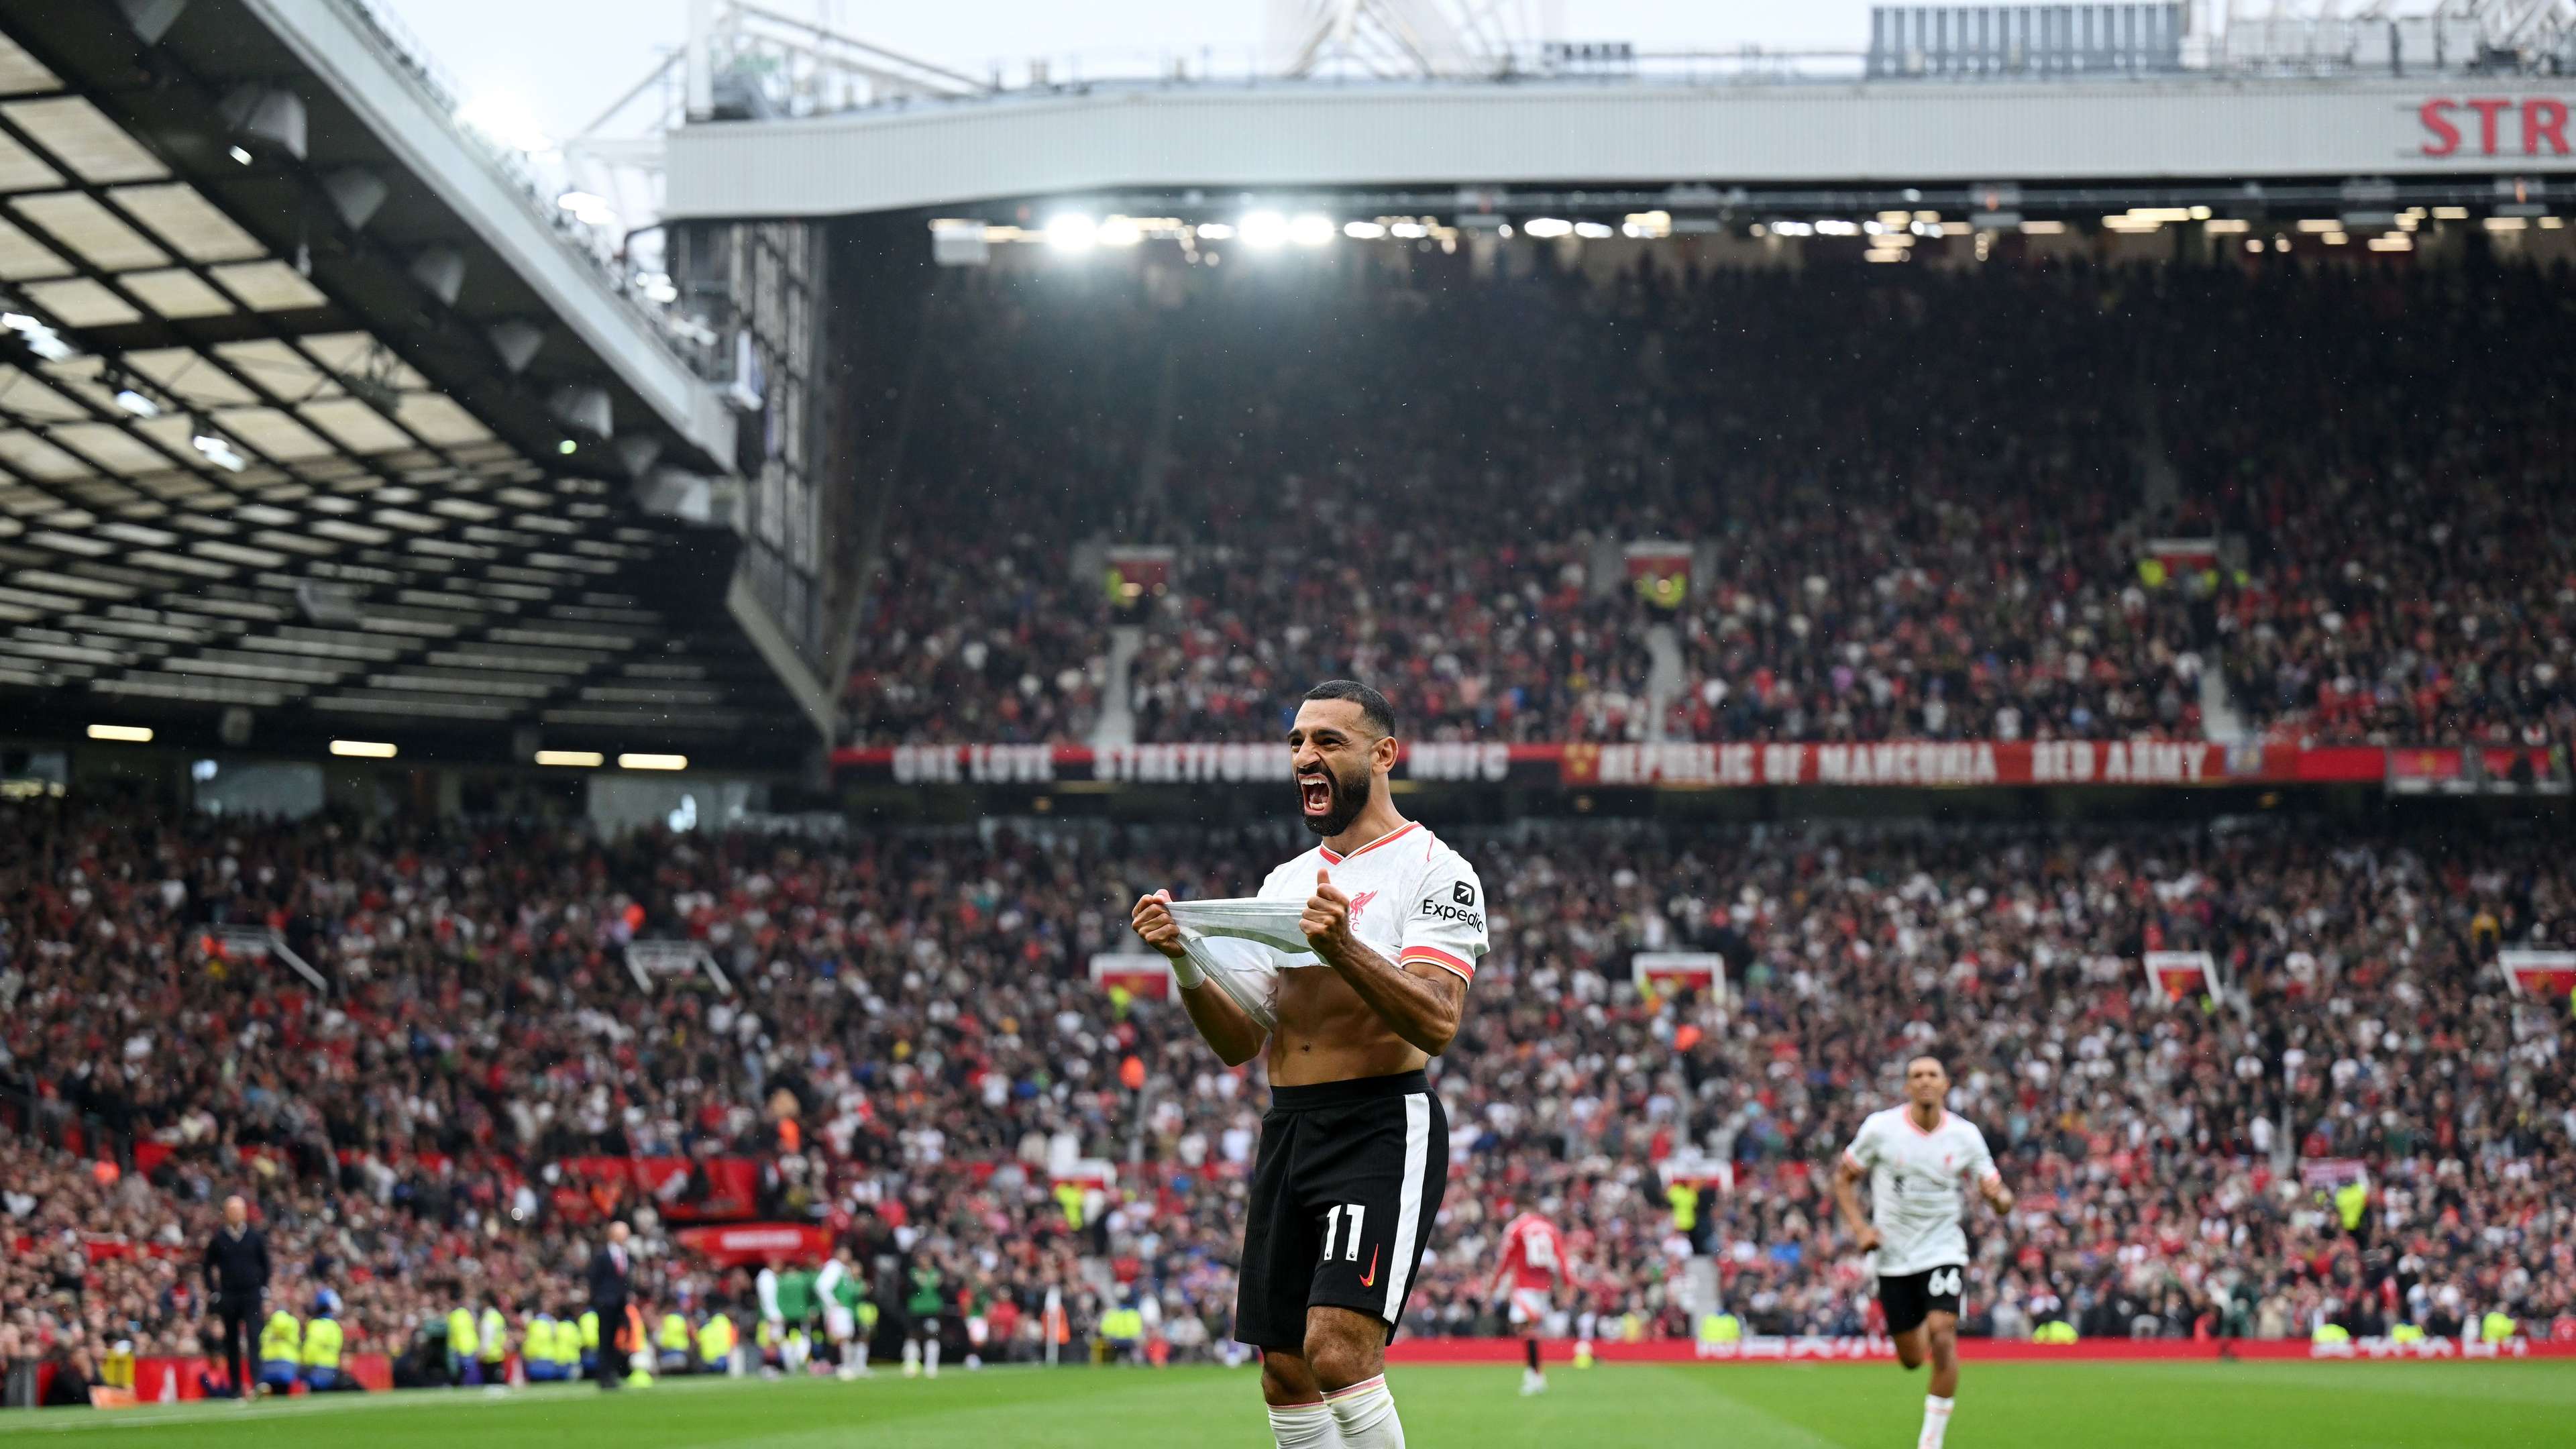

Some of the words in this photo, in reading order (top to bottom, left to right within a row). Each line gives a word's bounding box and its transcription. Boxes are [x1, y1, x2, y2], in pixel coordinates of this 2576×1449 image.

[2420, 97, 2571, 157] STR
[1599, 743, 1752, 785] REPUBLIC
[1763, 743, 1806, 784] OF
[2031, 741, 2096, 783] RED
[2105, 740, 2207, 783] ARMY
[1324, 1204, 1365, 1261] 11
[1928, 1267, 1962, 1296] 66
